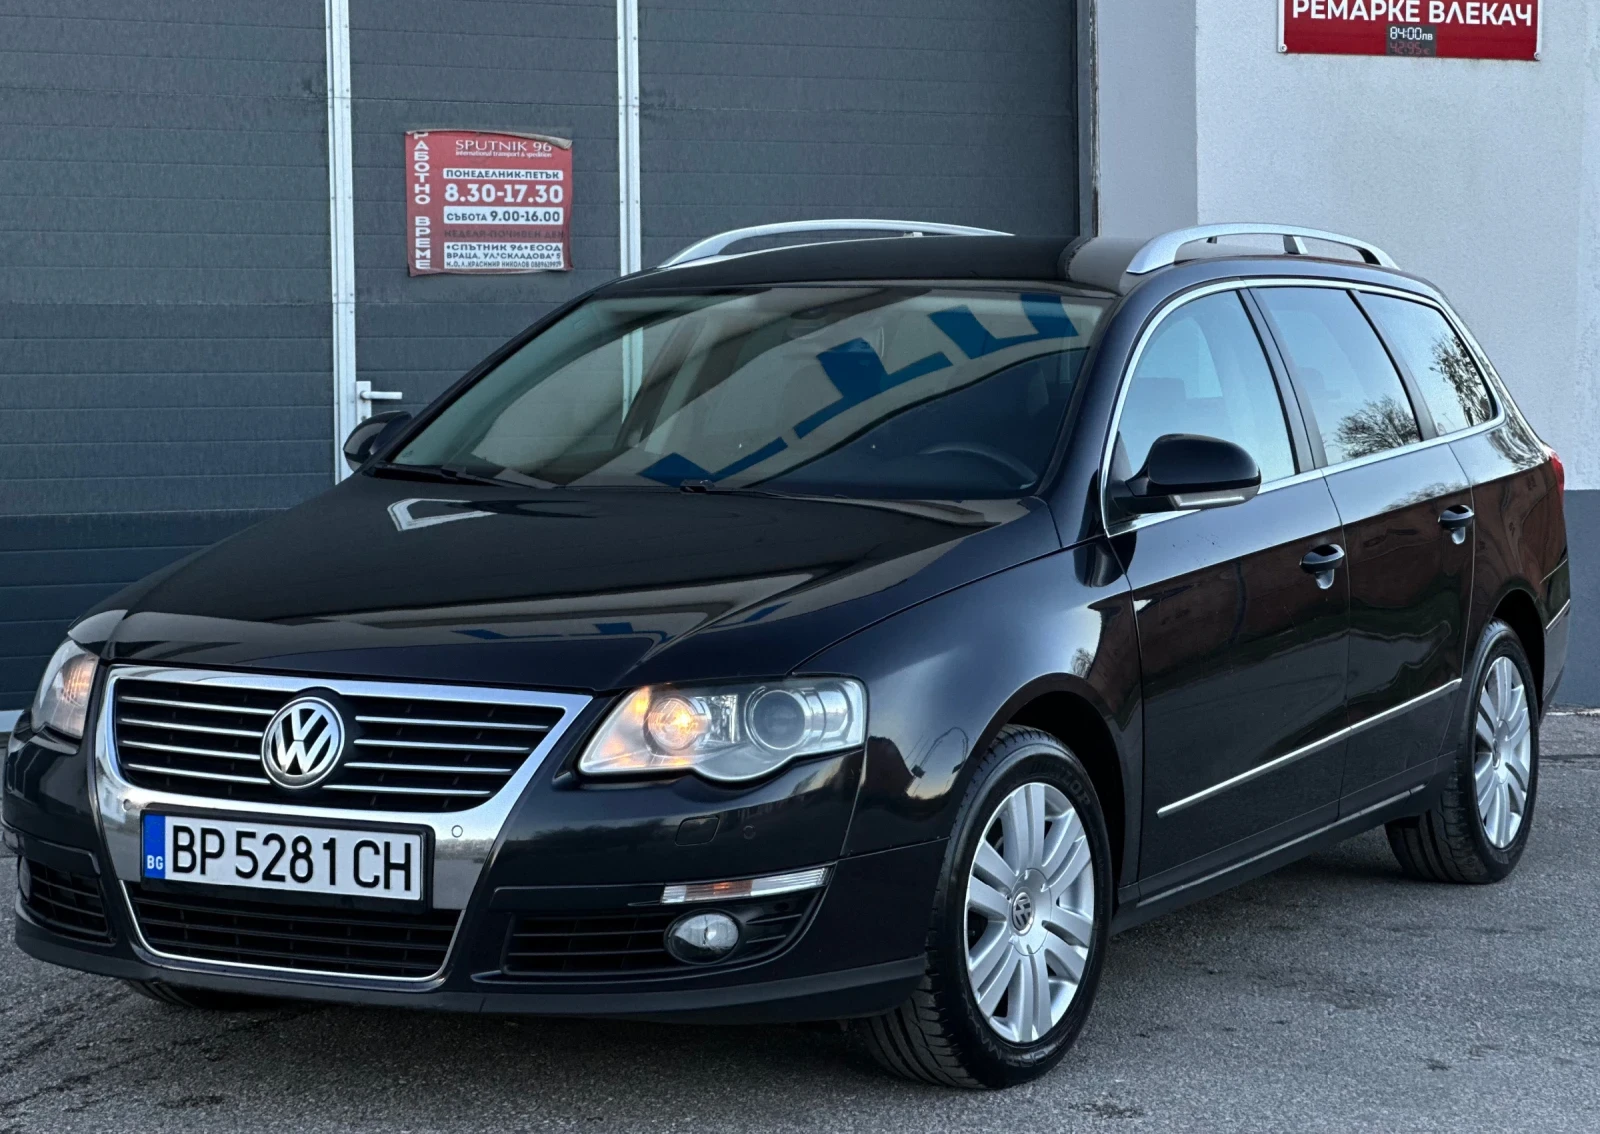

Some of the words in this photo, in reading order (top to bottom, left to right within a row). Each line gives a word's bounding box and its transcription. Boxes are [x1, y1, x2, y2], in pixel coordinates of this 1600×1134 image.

[1293, 0, 1421, 22] РЕМАРКЕ
[1429, 1, 1532, 26] ВЛЕКАЧ
[456, 139, 527, 151] SPUTNIK
[533, 141, 552, 152] 96
[446, 169, 560, 179] ПОНЕДЕЛНИК-ПЕТЪК
[445, 183, 563, 203] 8.30-17.30
[446, 213, 487, 221] СЪБОТА
[490, 210, 560, 222] 9.00-16.00
[415, 216, 431, 270] ВРЕМЕ
[147, 855, 164, 870] BG
[235, 830, 337, 885] 5281
